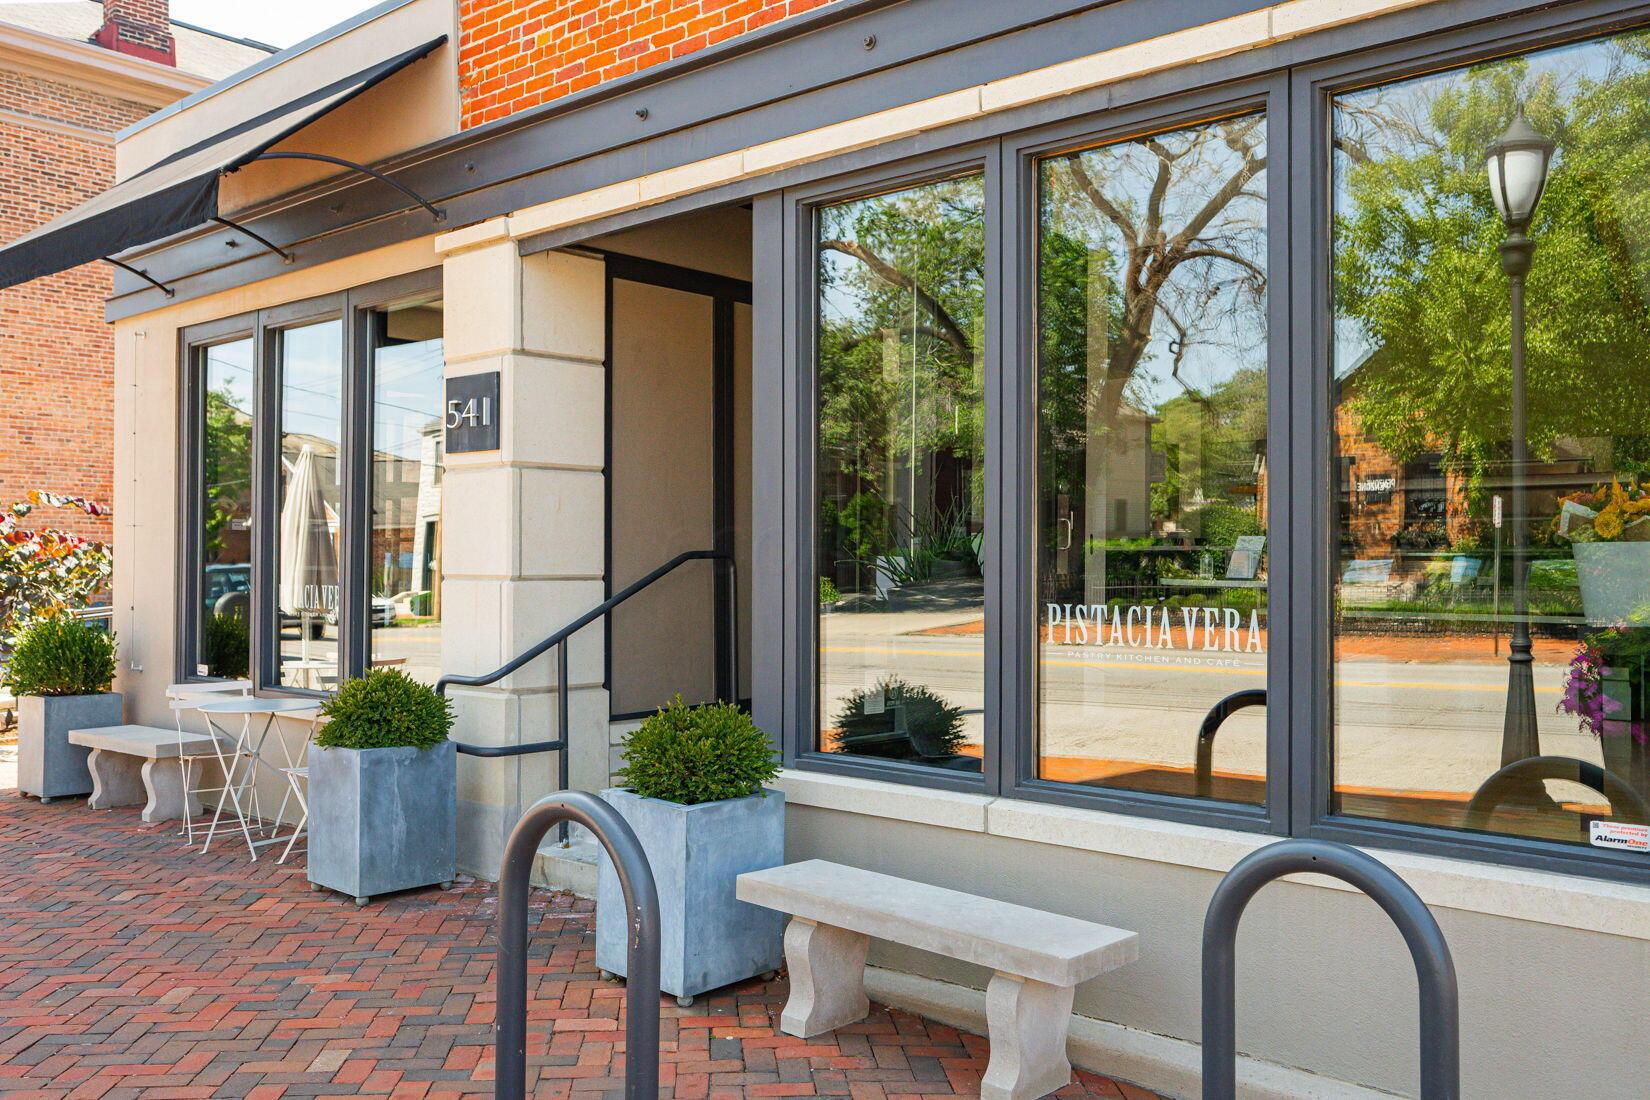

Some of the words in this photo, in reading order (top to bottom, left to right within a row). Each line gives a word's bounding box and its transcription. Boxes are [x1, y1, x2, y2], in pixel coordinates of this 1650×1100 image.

[446, 396, 491, 429] 541
[1046, 603, 1175, 650] PISTACIA
[1180, 606, 1264, 654] VERA
[1067, 650, 1112, 660] PASTRY
[1116, 653, 1170, 664] KITCHEN
[1175, 655, 1201, 665] AND
[1595, 835, 1648, 846] AlarmOne
